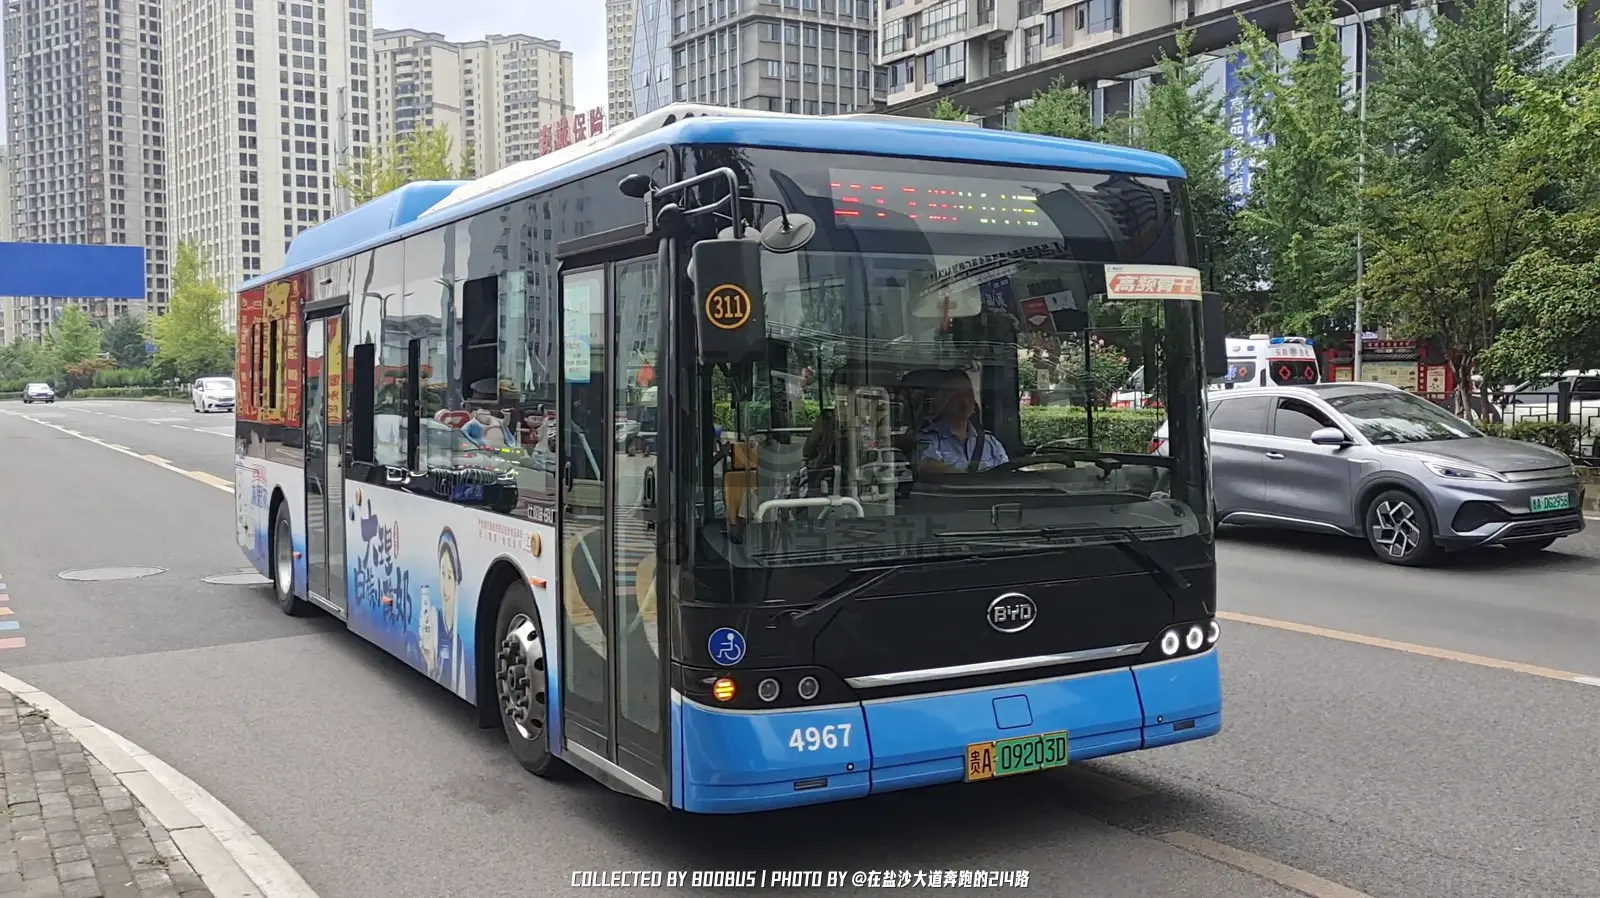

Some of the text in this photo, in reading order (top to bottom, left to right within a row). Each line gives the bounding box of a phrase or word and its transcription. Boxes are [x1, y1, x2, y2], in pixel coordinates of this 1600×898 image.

[713, 295, 743, 318] 311
[994, 604, 1031, 623] BYD
[789, 723, 852, 752] 4967
